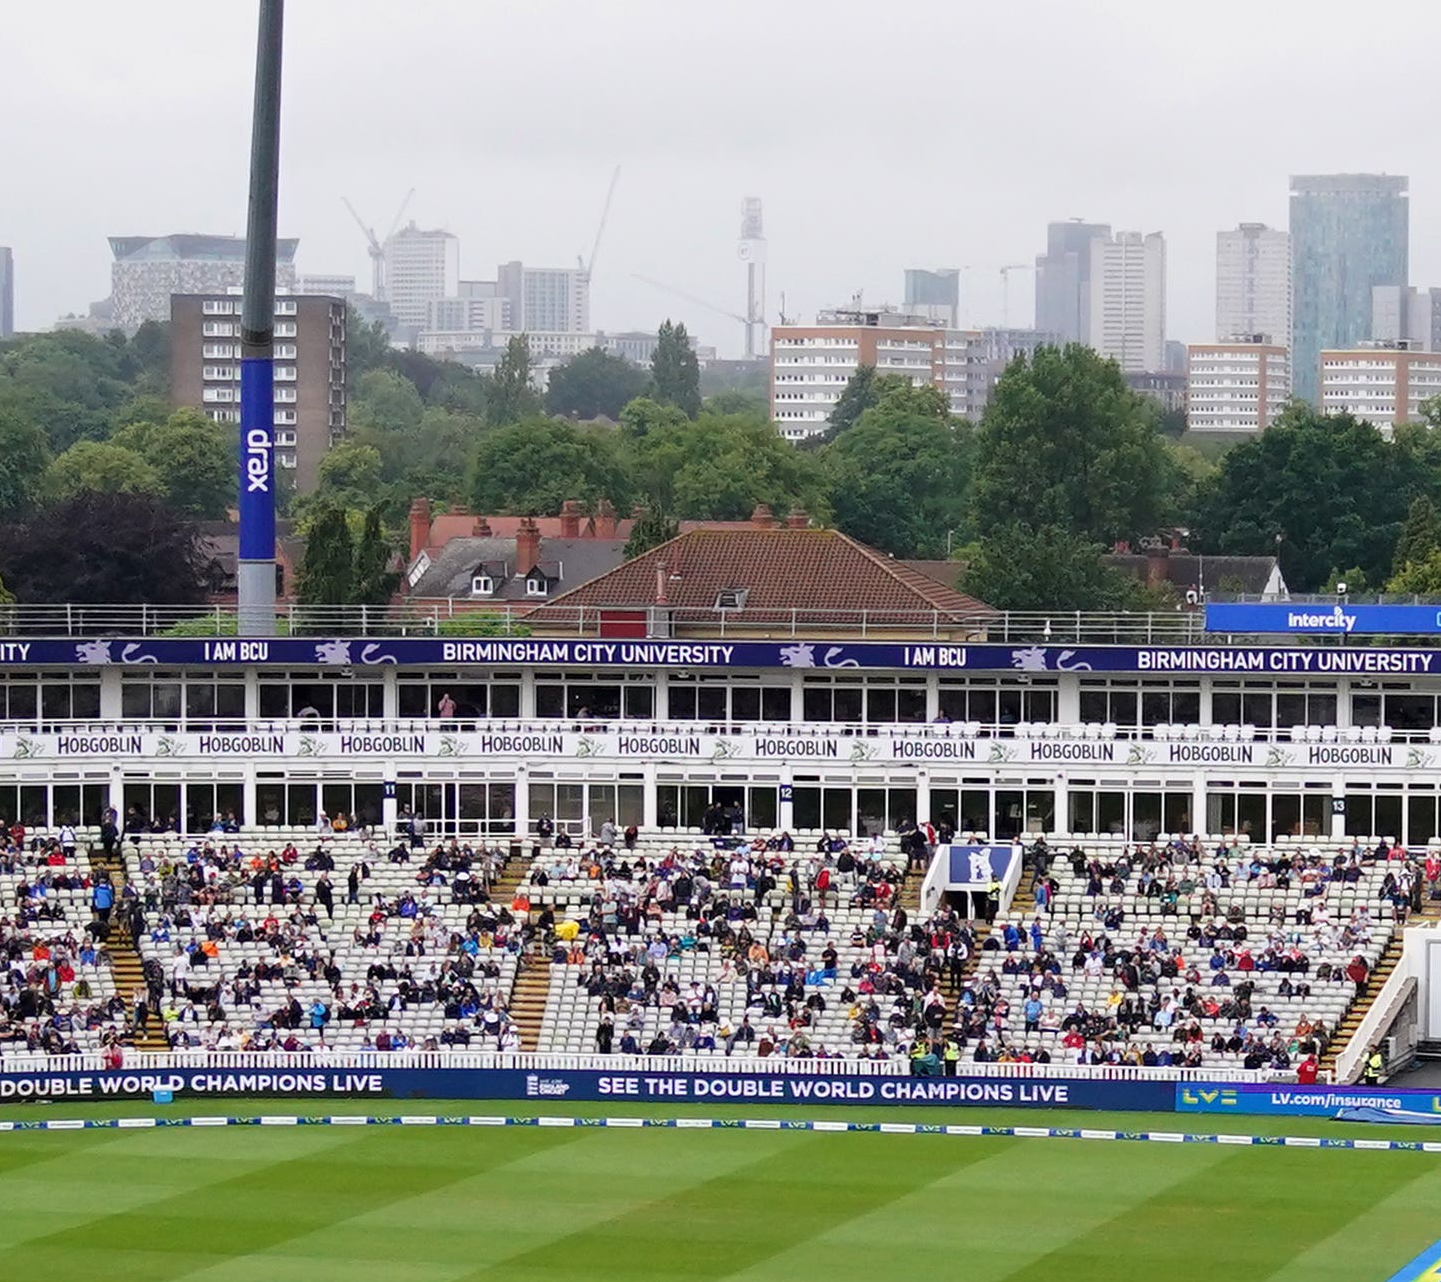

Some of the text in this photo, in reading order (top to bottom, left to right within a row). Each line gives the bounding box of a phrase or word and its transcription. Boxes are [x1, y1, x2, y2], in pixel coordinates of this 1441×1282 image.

[246, 428, 272, 492] drax
[1288, 606, 1356, 632] intercity
[443, 643, 734, 664] BIRMINGHAM CITY UNIVERSITY
[904, 647, 967, 667] I AM BCU
[1137, 650, 1433, 673] BIRMINGHAM CITY UNIVERSITY
[57, 736, 142, 755] HOBGOBLIN
[755, 738, 838, 757] HOBGOBLIN
[1031, 742, 1114, 761] HOBGOBLIN
[1309, 745, 1392, 764] HOBGOBLIN
[385, 784, 396, 796] 11
[780, 787, 793, 799] 12
[1333, 799, 1345, 813] 13
[0, 1077, 93, 1097] DOUBLE
[99, 1075, 182, 1094] WORLD
[191, 1074, 327, 1093] CHAMPIONS
[333, 1074, 383, 1093] LIVE
[598, 1076, 1069, 1103] SEE THE DOUBLE WORLD CHAMPIONS LIVE
[1271, 1092, 1402, 1112] LV.com/insurance
